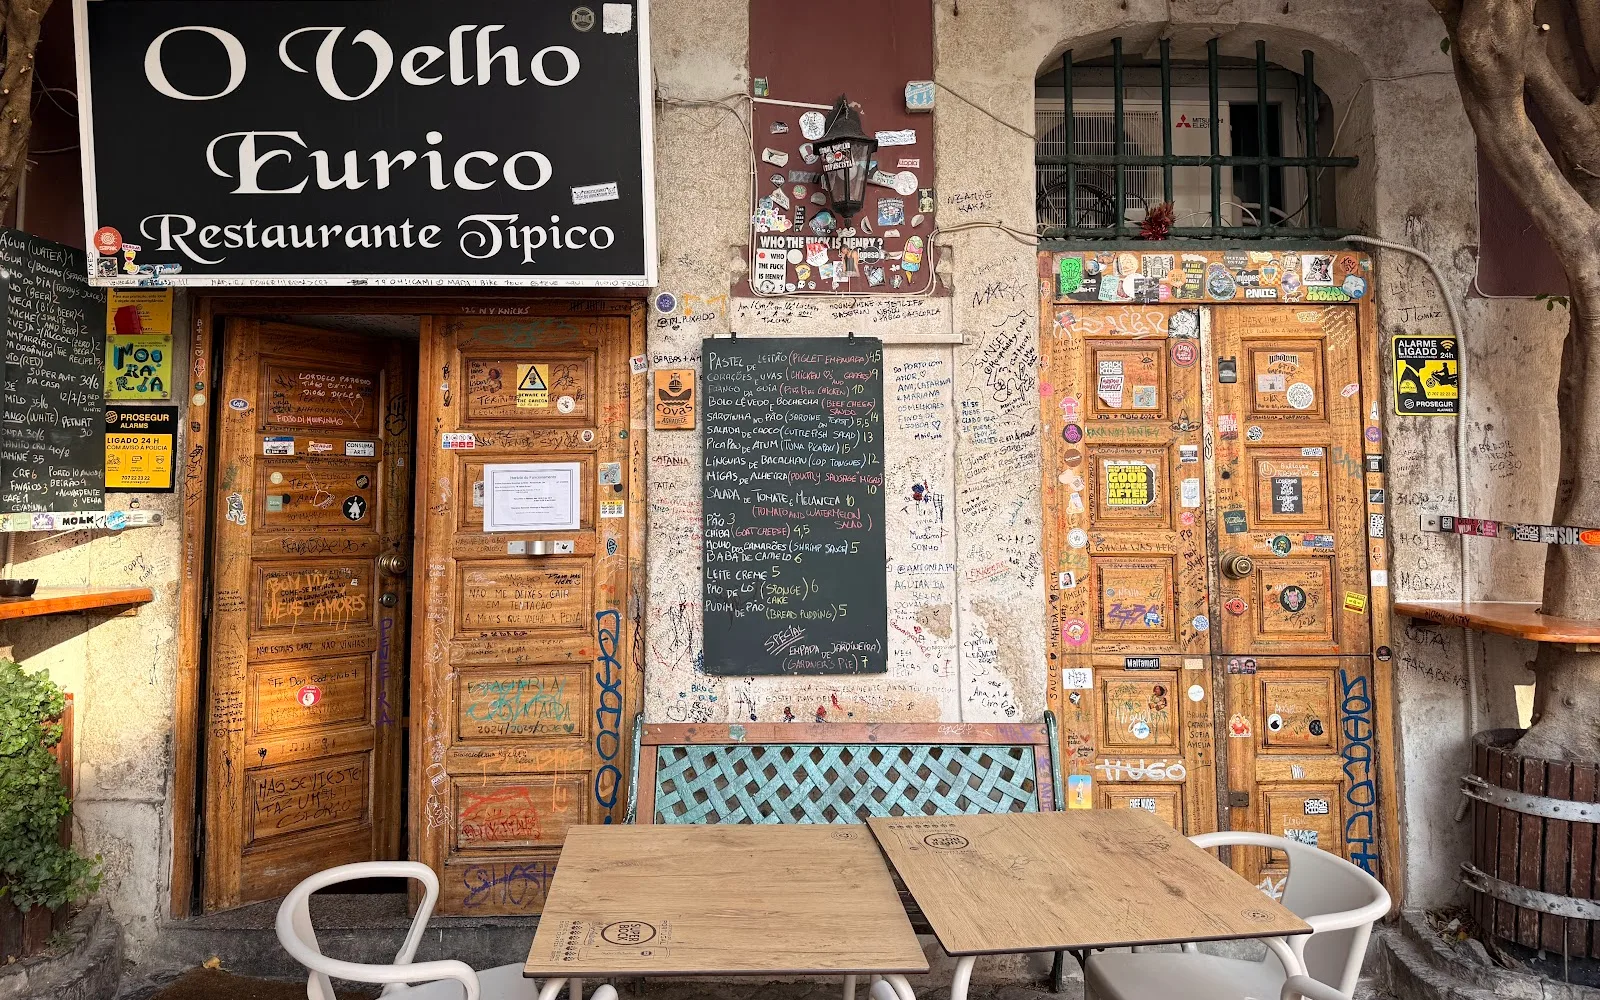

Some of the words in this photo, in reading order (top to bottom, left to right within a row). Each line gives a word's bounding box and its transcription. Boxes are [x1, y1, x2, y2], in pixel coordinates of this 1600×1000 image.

[144, 26, 246, 100] O
[278, 24, 580, 100] Velho
[206, 130, 552, 194] Eurico
[140, 214, 450, 264] Restaurante
[458, 214, 615, 264] Típico
[761, 236, 784, 248] WHO
[787, 236, 804, 248] THE
[805, 237, 830, 248] FUCK
[832, 237, 842, 248] IS
[844, 238, 875, 248] HENRY
[28, 240, 67, 267] (WATER)
[20, 353, 43, 368] (RED)
[709, 352, 744, 370] PASTEL
[760, 371, 782, 380] UVAS
[872, 369, 878, 380] 9
[41, 379, 60, 389] CASA
[708, 385, 740, 393] FRANGO
[852, 385, 863, 394] 10
[656, 403, 693, 416] covas
[27, 407, 58, 426] (WHITE)
[120, 413, 169, 421] PROSEGUR
[706, 413, 751, 421] SARDINHA
[765, 412, 783, 421] PÃO
[857, 418, 869, 428] 5,5
[870, 413, 878, 422] 14
[80, 428, 92, 438] 30
[707, 426, 740, 434] SALADA
[863, 432, 873, 442] 13
[752, 439, 778, 449] ATUM
[781, 439, 804, 452] (TUNA
[841, 444, 850, 453] 15
[33, 454, 44, 464] 35
[761, 456, 806, 464] BACALHAU
[868, 453, 879, 463] 12
[707, 471, 737, 481] MIGAS
[739, 477, 749, 485] DE
[1109, 473, 1146, 482] GOOD
[41, 484, 48, 494] 3
[867, 485, 877, 494] 10
[1109, 489, 1147, 497] AFTER
[707, 486, 740, 500] SALADA
[751, 488, 787, 502] TOMATE
[847, 495, 854, 506] 10
[707, 513, 724, 526] PÃO
[727, 513, 735, 525] 3
[789, 511, 804, 519] AND
[707, 541, 731, 549] MOLHO
[744, 540, 791, 551] CAMARÕES
[850, 542, 860, 553] 5
[707, 551, 739, 562] BABA
[755, 552, 791, 561] CAMELO
[794, 553, 802, 563] 6
[736, 571, 767, 580] CREME
[772, 566, 780, 577] 5
[496, 590, 507, 598] ME
[515, 590, 542, 599] DEIXES
[550, 589, 569, 598] CAIR
[707, 580, 722, 594] PÃO
[727, 589, 738, 597] DE
[741, 582, 755, 592] LÓ
[811, 579, 818, 592] 6
[746, 600, 765, 612] PÃO
[766, 608, 797, 619] (BREAD
[839, 604, 848, 617] 5
[508, 615, 520, 623] QUE
[789, 644, 820, 656] EMPADA
[861, 656, 868, 668] 7
[1127, 659, 1158, 669] Malfamati
[1190, 731, 1210, 739] SOFIA
[259, 778, 286, 800] MAS
[1130, 798, 1141, 808] FREE
[618, 924, 629, 941] BOCK
[629, 924, 641, 941] SUPER
